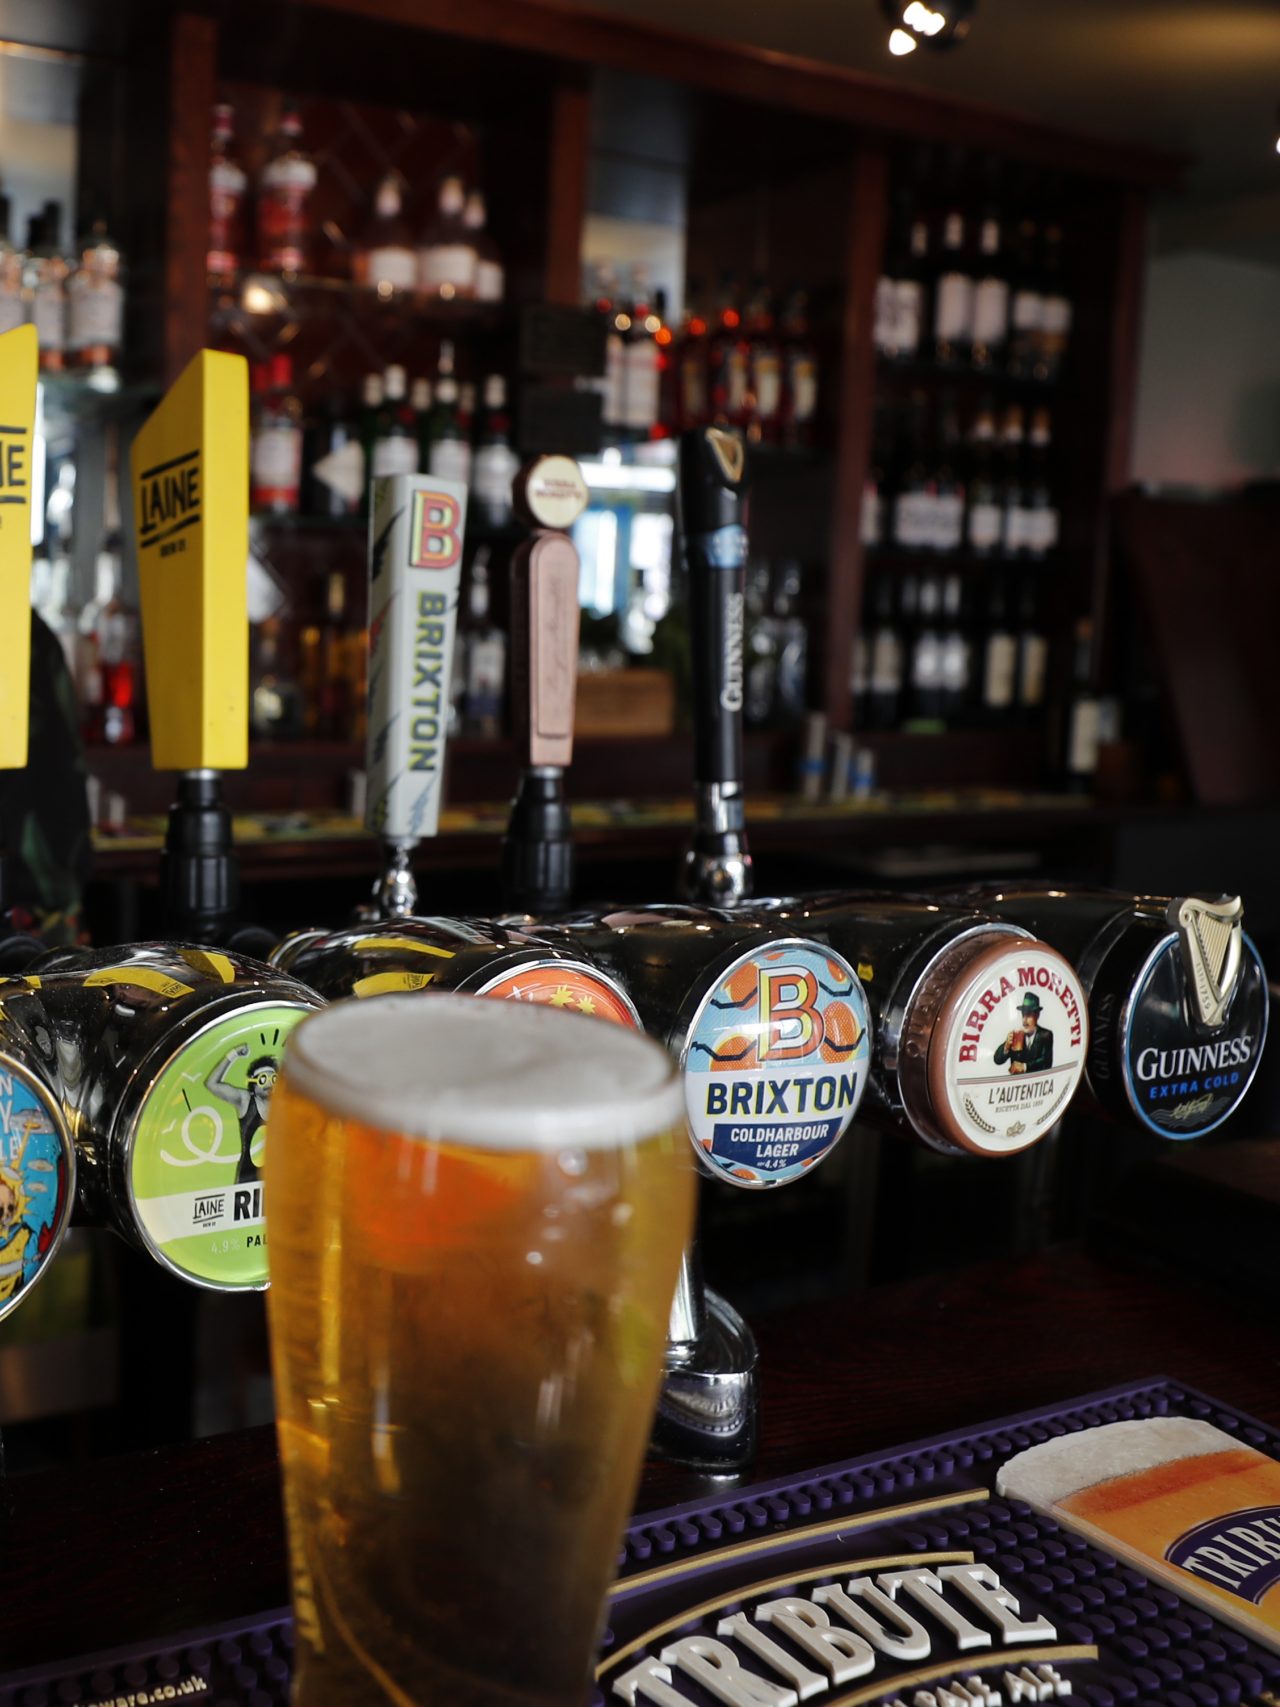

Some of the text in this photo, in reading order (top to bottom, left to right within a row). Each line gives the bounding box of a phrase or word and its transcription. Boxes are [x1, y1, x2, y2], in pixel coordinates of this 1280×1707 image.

[140, 466, 200, 535] LAINE
[409, 489, 462, 570] B
[720, 592, 744, 712] GUINNESS
[409, 590, 447, 772] BRIXTON
[757, 965, 825, 1062] B
[958, 966, 1081, 1063] BIRRA MORETTI
[1136, 1035, 1252, 1081] GUINNESS
[706, 1072, 858, 1117] BRIXTON
[988, 1079, 1054, 1104] L'AUTENTICA
[1149, 1071, 1240, 1099] EXTRA COLD
[730, 1124, 829, 1142] COLDHARBOUR
[756, 1143, 799, 1158] LAGER
[193, 1198, 225, 1219] LAINE
[247, 1234, 267, 1248] PAL
[613, 1562, 1058, 1707] TRIBUTE
[1004, 1663, 1072, 1703] ALE
